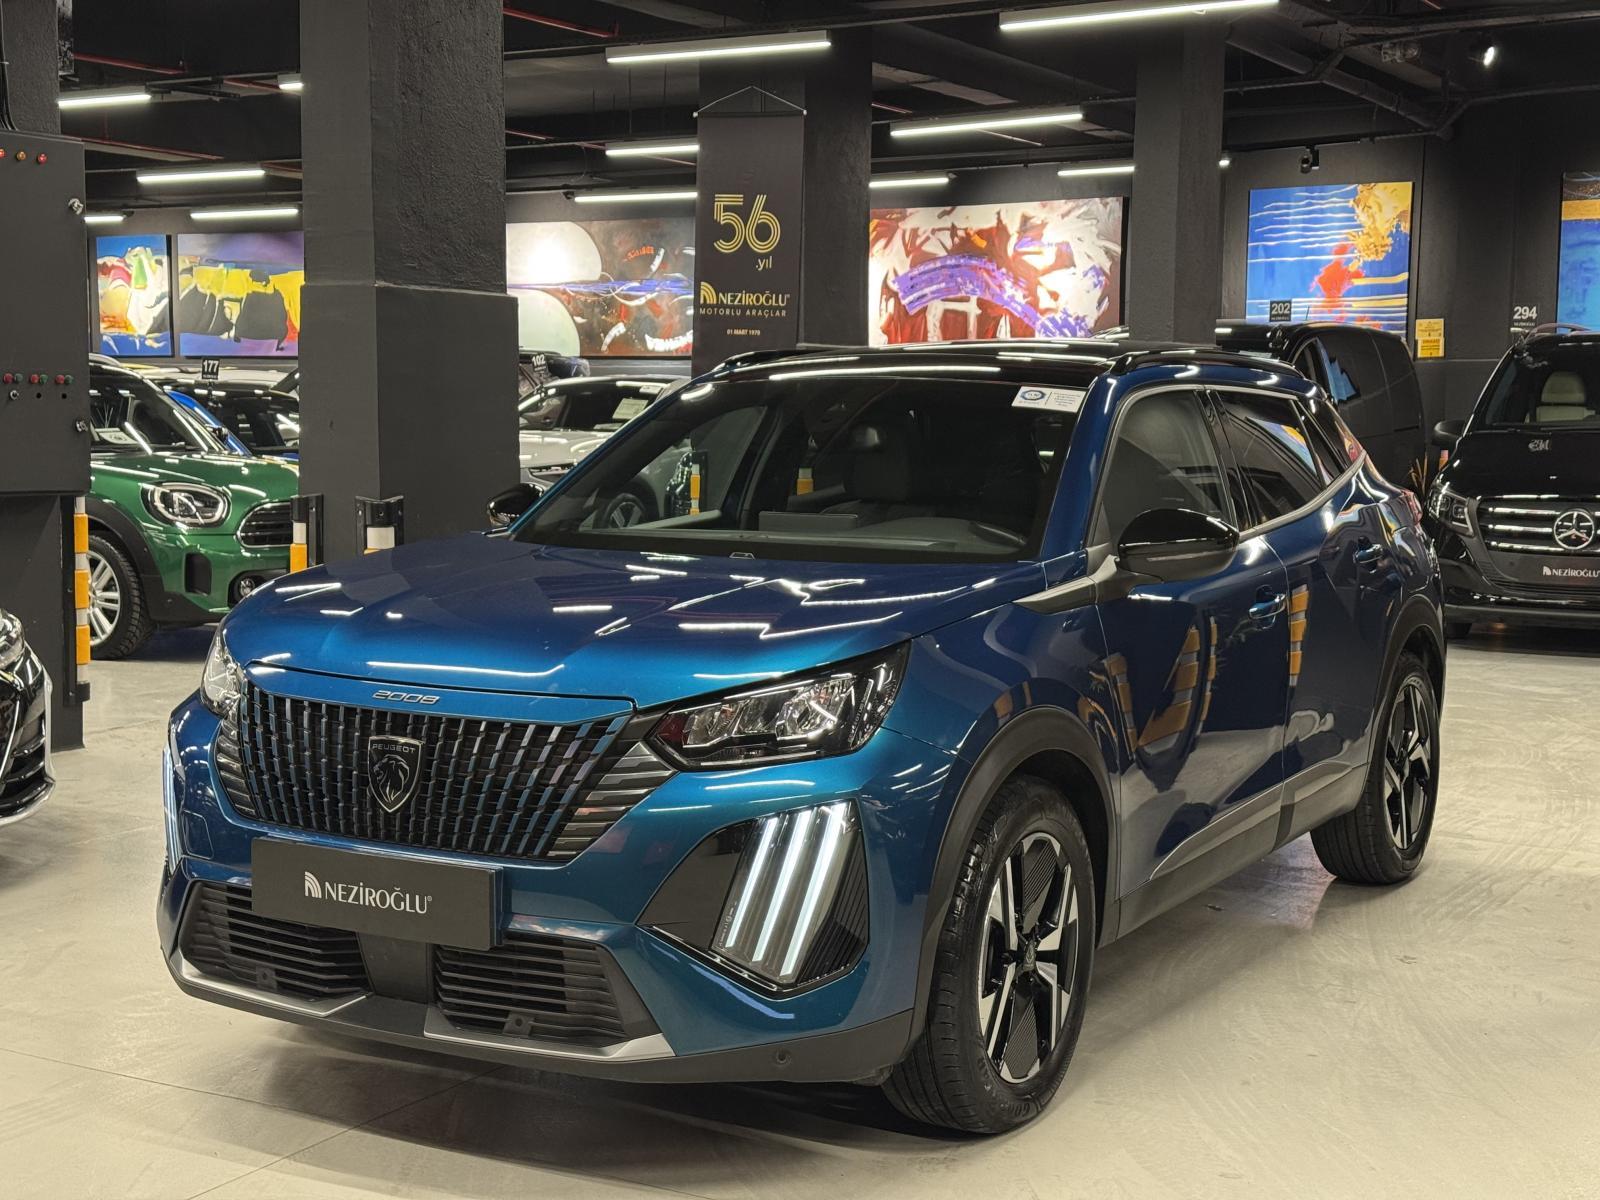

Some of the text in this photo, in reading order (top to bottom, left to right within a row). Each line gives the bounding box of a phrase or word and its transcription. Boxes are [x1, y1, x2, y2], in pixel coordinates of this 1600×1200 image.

[713, 194, 781, 253] 56
[700, 307, 787, 318] MOTORLU ARAÇLAR
[1271, 302, 1291, 314] 202
[1513, 306, 1538, 320] 294
[203, 359, 219, 373] 177
[372, 690, 440, 705] 2008
[372, 743, 416, 754] PEUGEOT
